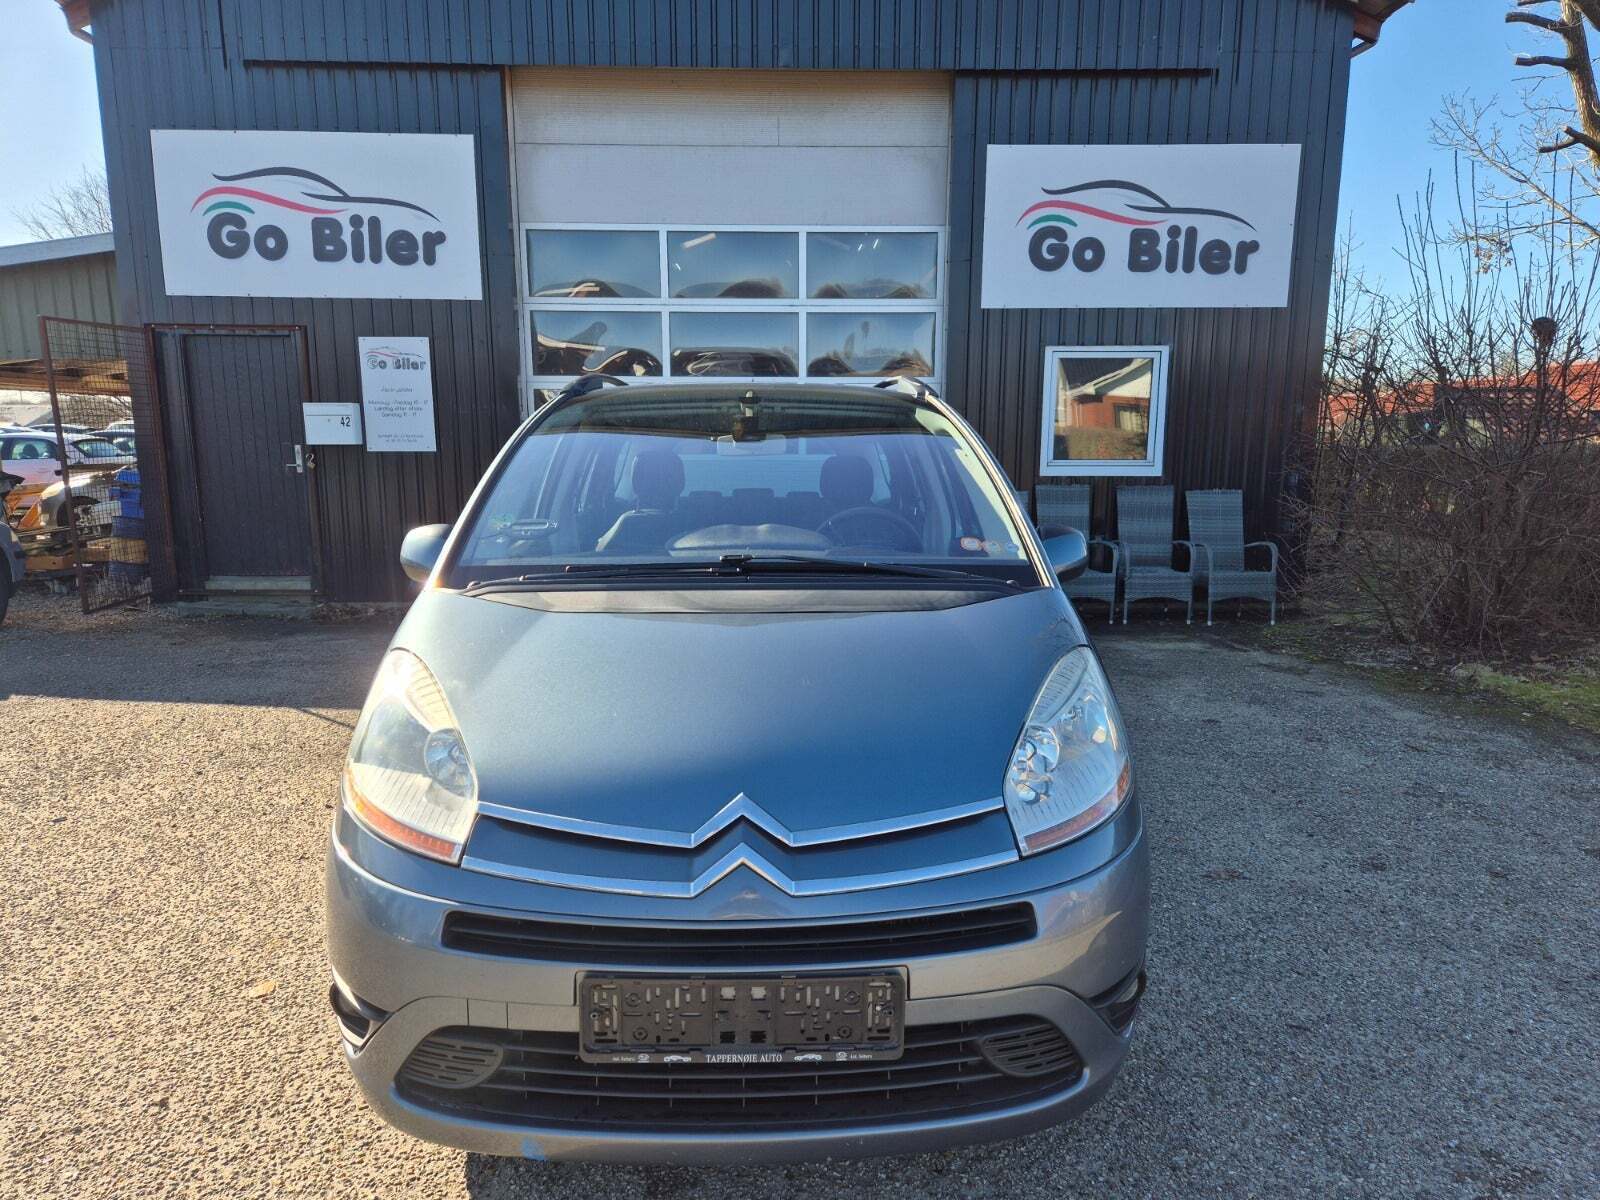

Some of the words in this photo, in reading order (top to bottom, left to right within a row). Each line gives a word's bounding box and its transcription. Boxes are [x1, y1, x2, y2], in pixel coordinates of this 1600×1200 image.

[207, 211, 288, 262] Go
[312, 215, 447, 265] Biler
[1029, 226, 1106, 273] Go
[1128, 225, 1260, 275] Biler
[340, 416, 351, 427] 42
[760, 1053, 783, 1063] AUTO
